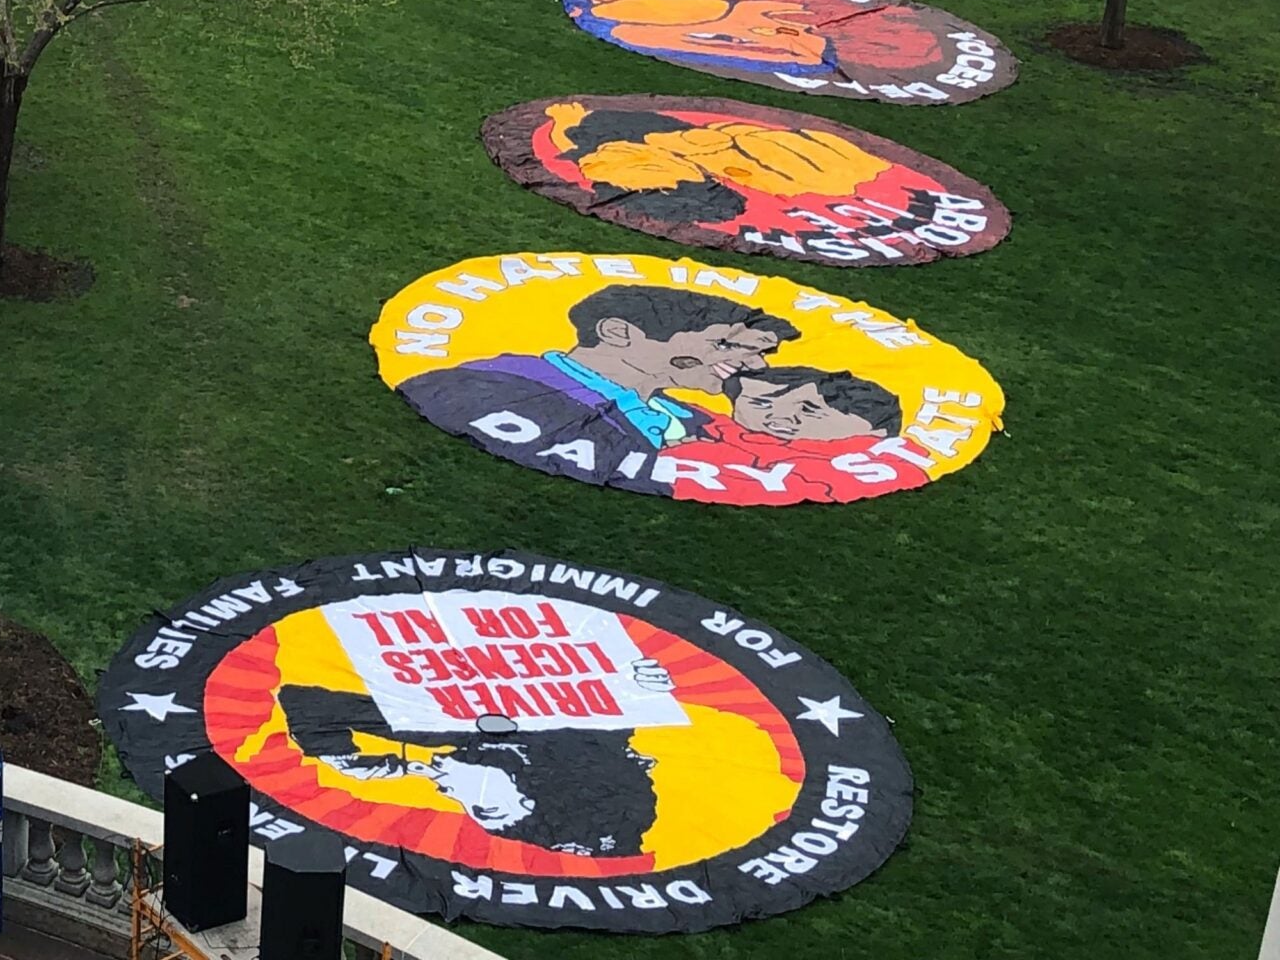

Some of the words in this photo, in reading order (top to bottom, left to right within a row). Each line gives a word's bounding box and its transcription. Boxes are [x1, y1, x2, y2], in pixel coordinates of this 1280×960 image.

[395, 301, 465, 359] NO
[435, 256, 647, 303] HATE
[668, 263, 761, 297] IN
[468, 408, 800, 494] DAIRY
[829, 385, 985, 485] STATE
[350, 554, 662, 609] IMMIGRANT
[132, 577, 307, 672] FAMILIES
[351, 611, 445, 647] ALL
[461, 601, 570, 638] FOR
[700, 610, 803, 671] FOR
[381, 641, 619, 684] LICENSES
[424, 677, 625, 721] DRIVER
[738, 762, 872, 887] RESTORE
[451, 868, 716, 913] DRIVER
